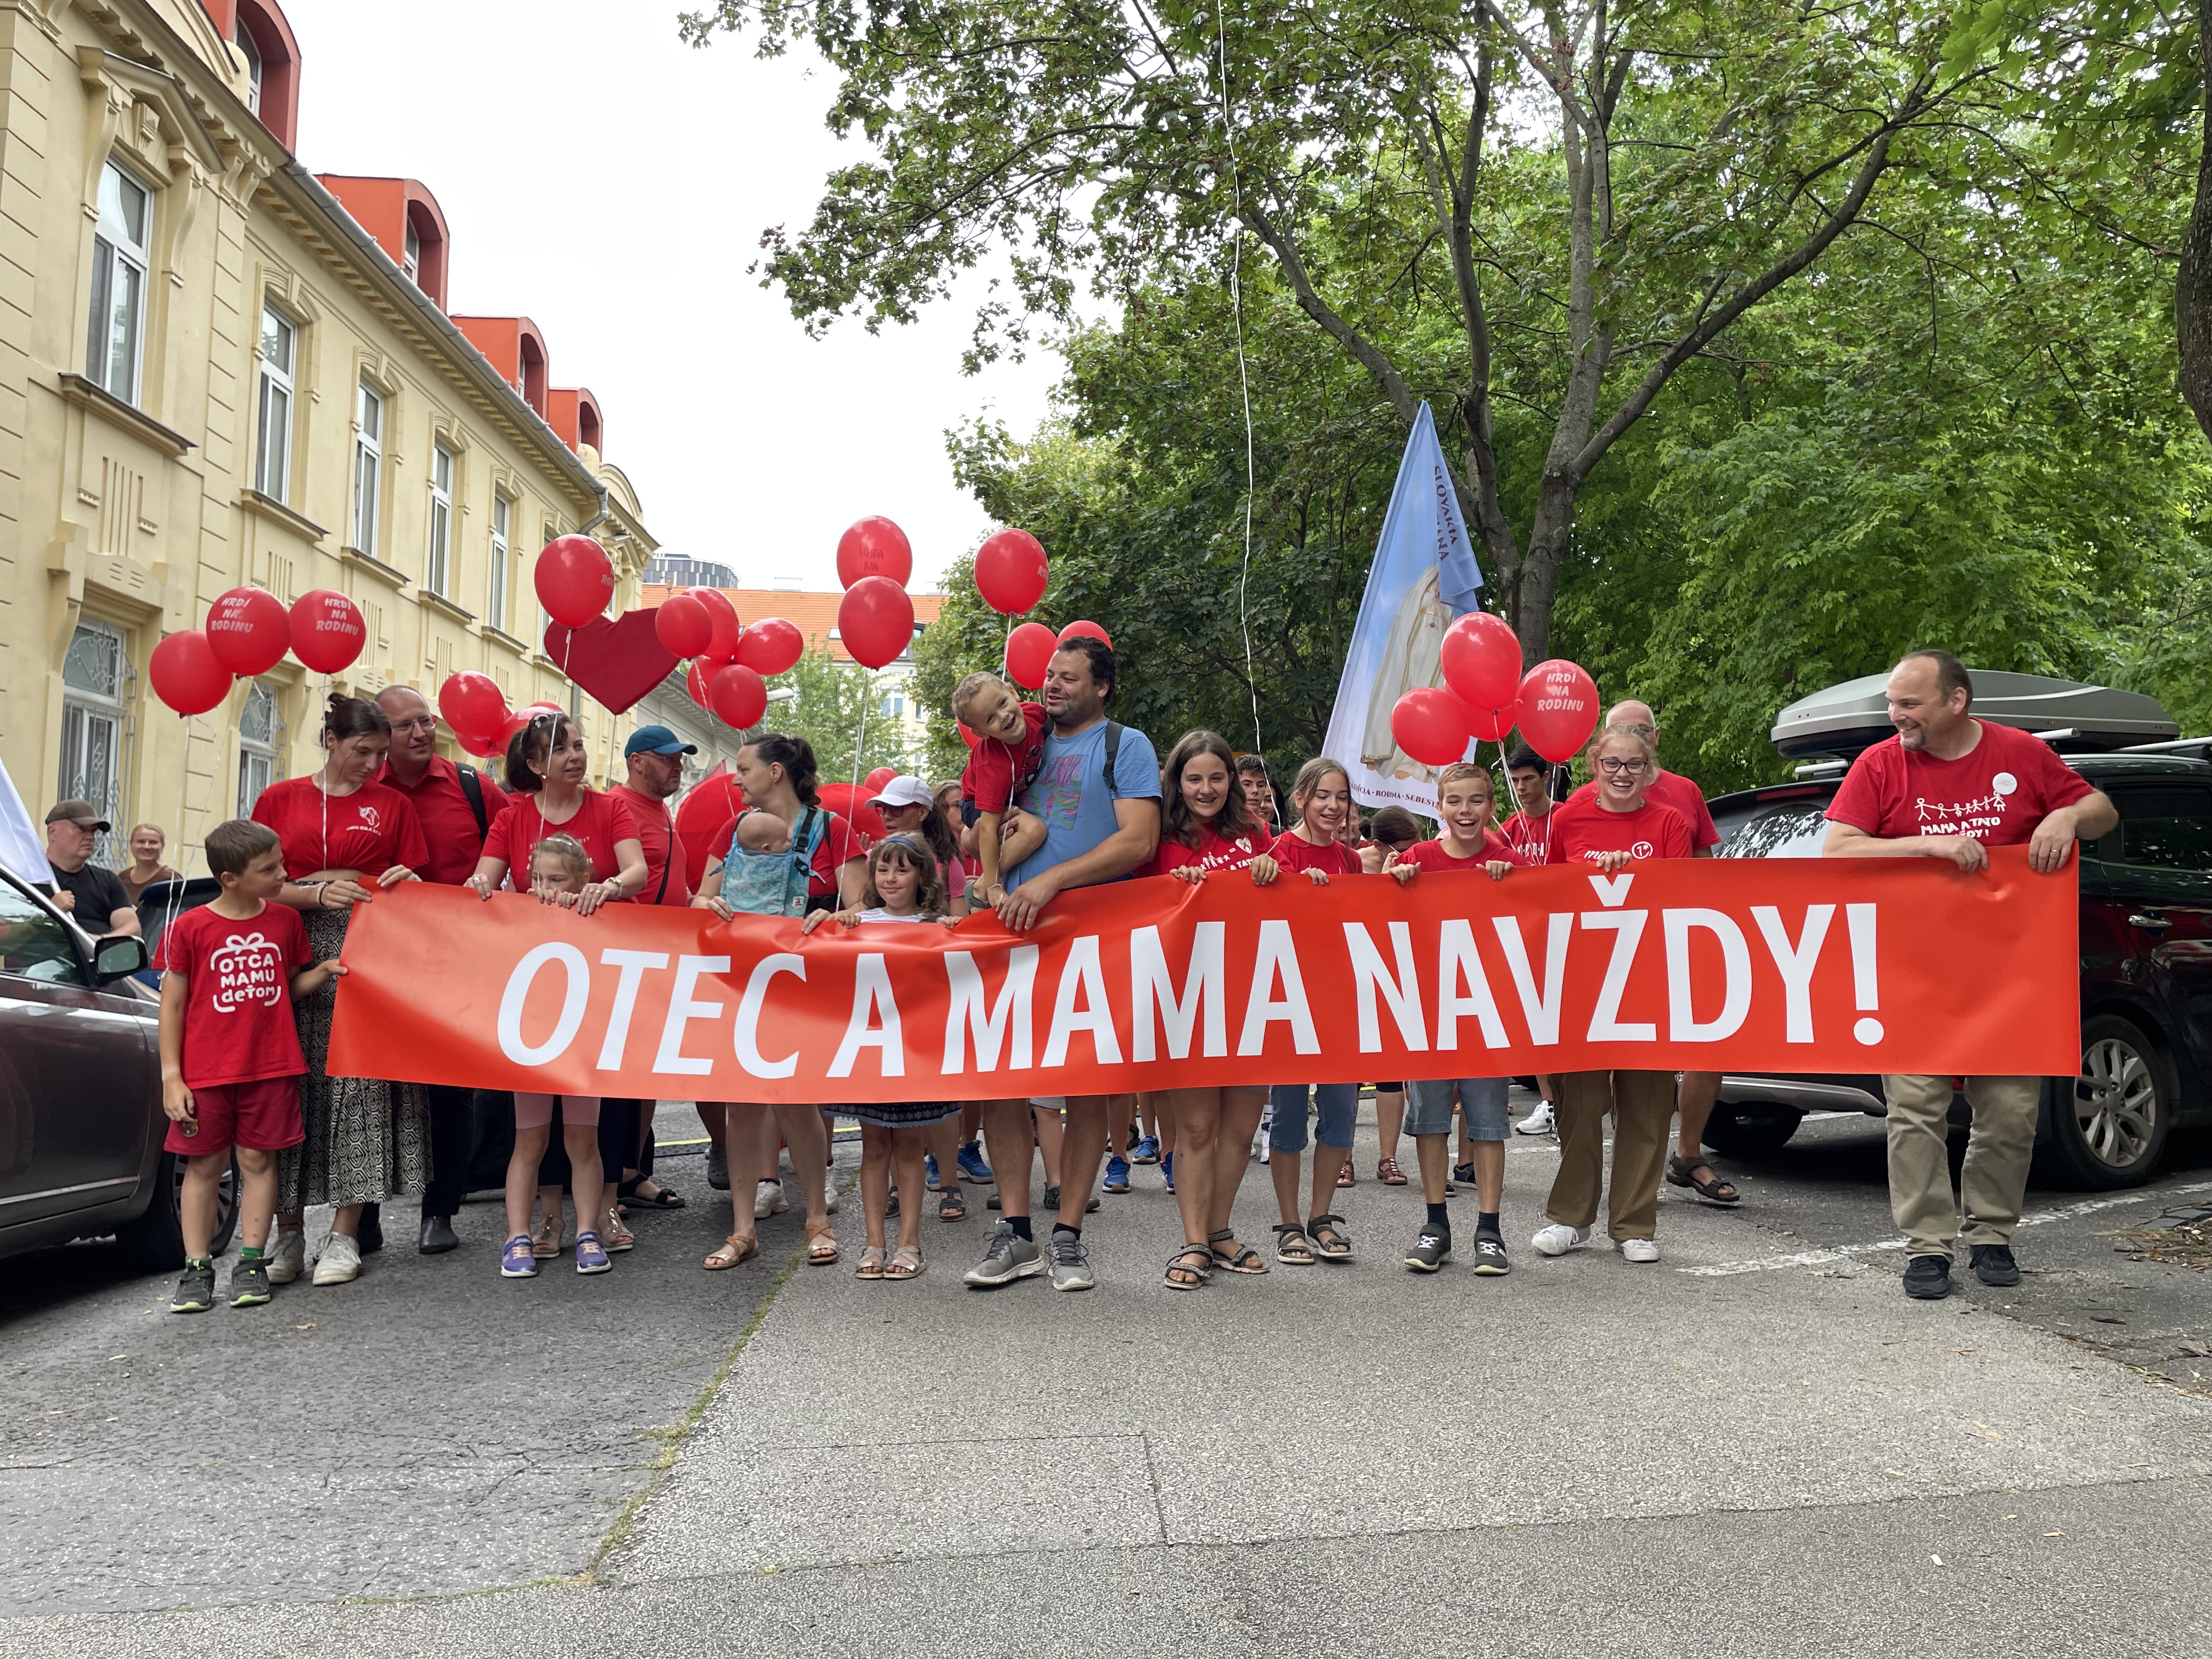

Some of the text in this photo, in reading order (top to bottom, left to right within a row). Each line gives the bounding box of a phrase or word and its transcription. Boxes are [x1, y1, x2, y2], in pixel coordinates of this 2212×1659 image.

[222, 609, 240, 618] NA
[331, 610, 347, 620] NA
[211, 620, 254, 633] RODINU
[315, 620, 359, 636] RODINU
[1546, 672, 1577, 684] HRDÍ
[1552, 685, 1570, 696] NA
[1537, 698, 1584, 712] RODINU
[1375, 790, 1401, 800] RODINA
[1404, 794, 1437, 808] SEBEST
[1920, 816, 2001, 836] MAMA A TATO
[219, 953, 274, 973] OTCA
[221, 969, 275, 989] MAMU
[497, 873, 1885, 1079] OTEC A MAMA NAVŽDY!
